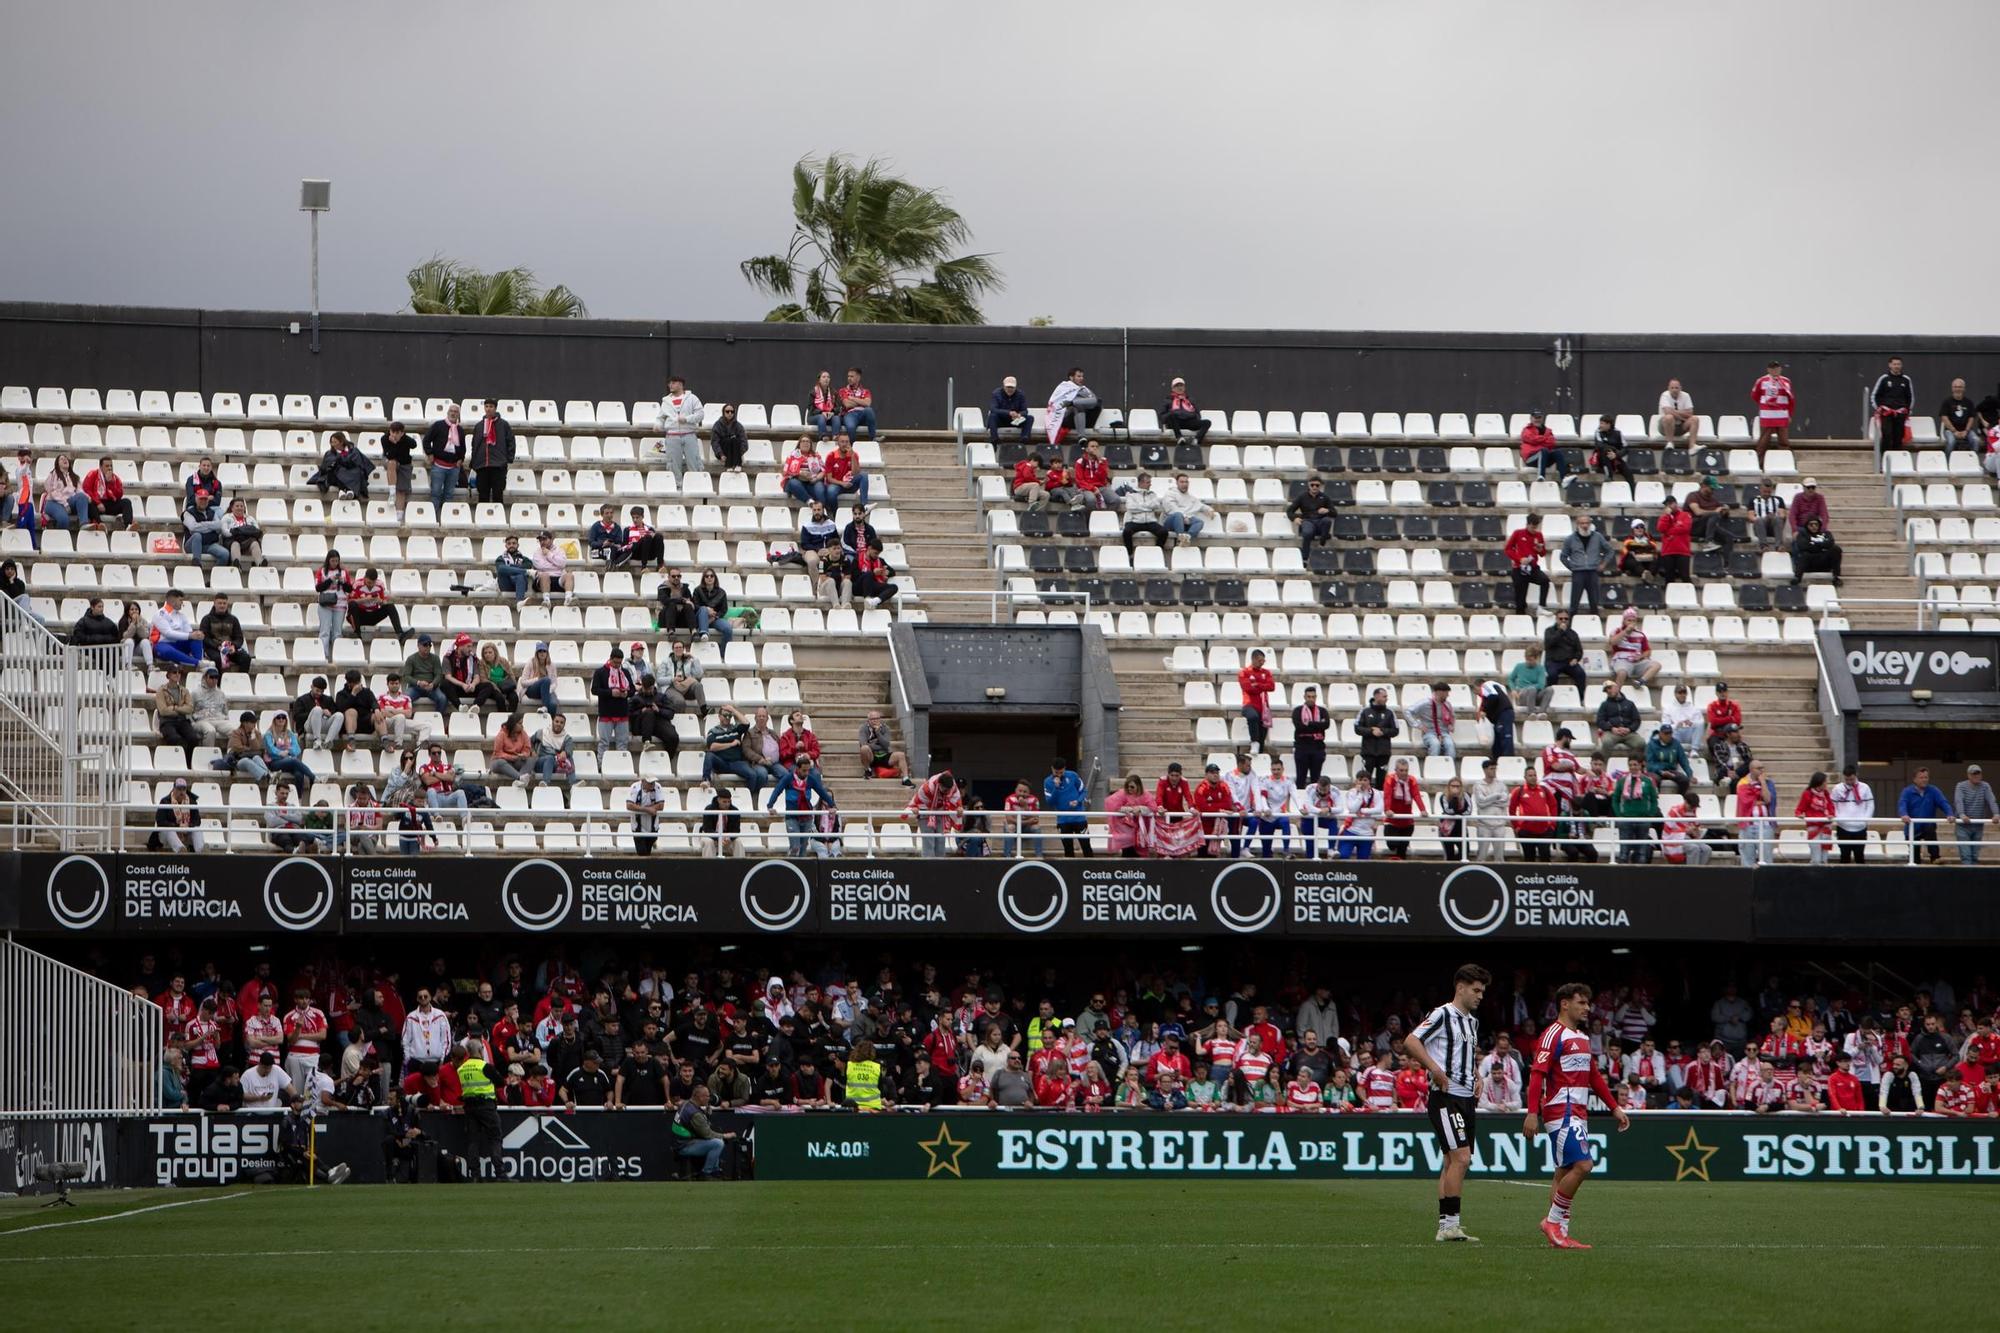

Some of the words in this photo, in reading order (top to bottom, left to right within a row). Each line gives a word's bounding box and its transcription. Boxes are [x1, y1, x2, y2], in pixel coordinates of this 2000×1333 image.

[1847, 641, 1924, 685] okey
[1866, 677, 1901, 685] Viviendas
[126, 865, 155, 874] Costa
[158, 865, 189, 874] Cálida
[351, 868, 381, 877] Costa
[582, 870, 612, 879] Costa
[615, 870, 647, 879] Cálida
[831, 870, 860, 880] Costa
[863, 870, 895, 880] Cálida
[1083, 870, 1113, 880] Costa
[1294, 872, 1324, 881] Costa
[126, 877, 204, 897] REGIÓN
[1515, 874, 1545, 885] Costa
[1547, 875, 1579, 885] Cálida
[351, 880, 431, 900] REGIÓN
[582, 882, 661, 902] REGIÓN
[831, 881, 909, 902] REGIÓN
[1083, 882, 1161, 902] REGIÓN
[1294, 884, 1373, 904] REGIÓN
[1516, 887, 1594, 907] REGIÓN
[126, 900, 151, 917] DE
[159, 900, 241, 917] MURCIA
[351, 903, 377, 920] DE
[385, 903, 468, 920] MURCIA
[582, 904, 608, 921] DE
[615, 904, 698, 922] MURCIA
[831, 904, 857, 921] DE
[864, 904, 947, 921] MURCIA
[1083, 904, 1109, 921] DE
[1116, 904, 1198, 921] MURCIA
[1294, 906, 1321, 922] DE
[1328, 906, 1410, 923] MURCIA
[1516, 909, 1542, 926] DE
[1549, 909, 1630, 926] MURCIA
[1449, 1112, 1465, 1129] 19
[997, 1129, 1297, 1172] ESTRELLA
[1299, 1141, 1337, 1161] DE
[1743, 1134, 2000, 1176] ESTRELL
[157, 1157, 238, 1185] group
